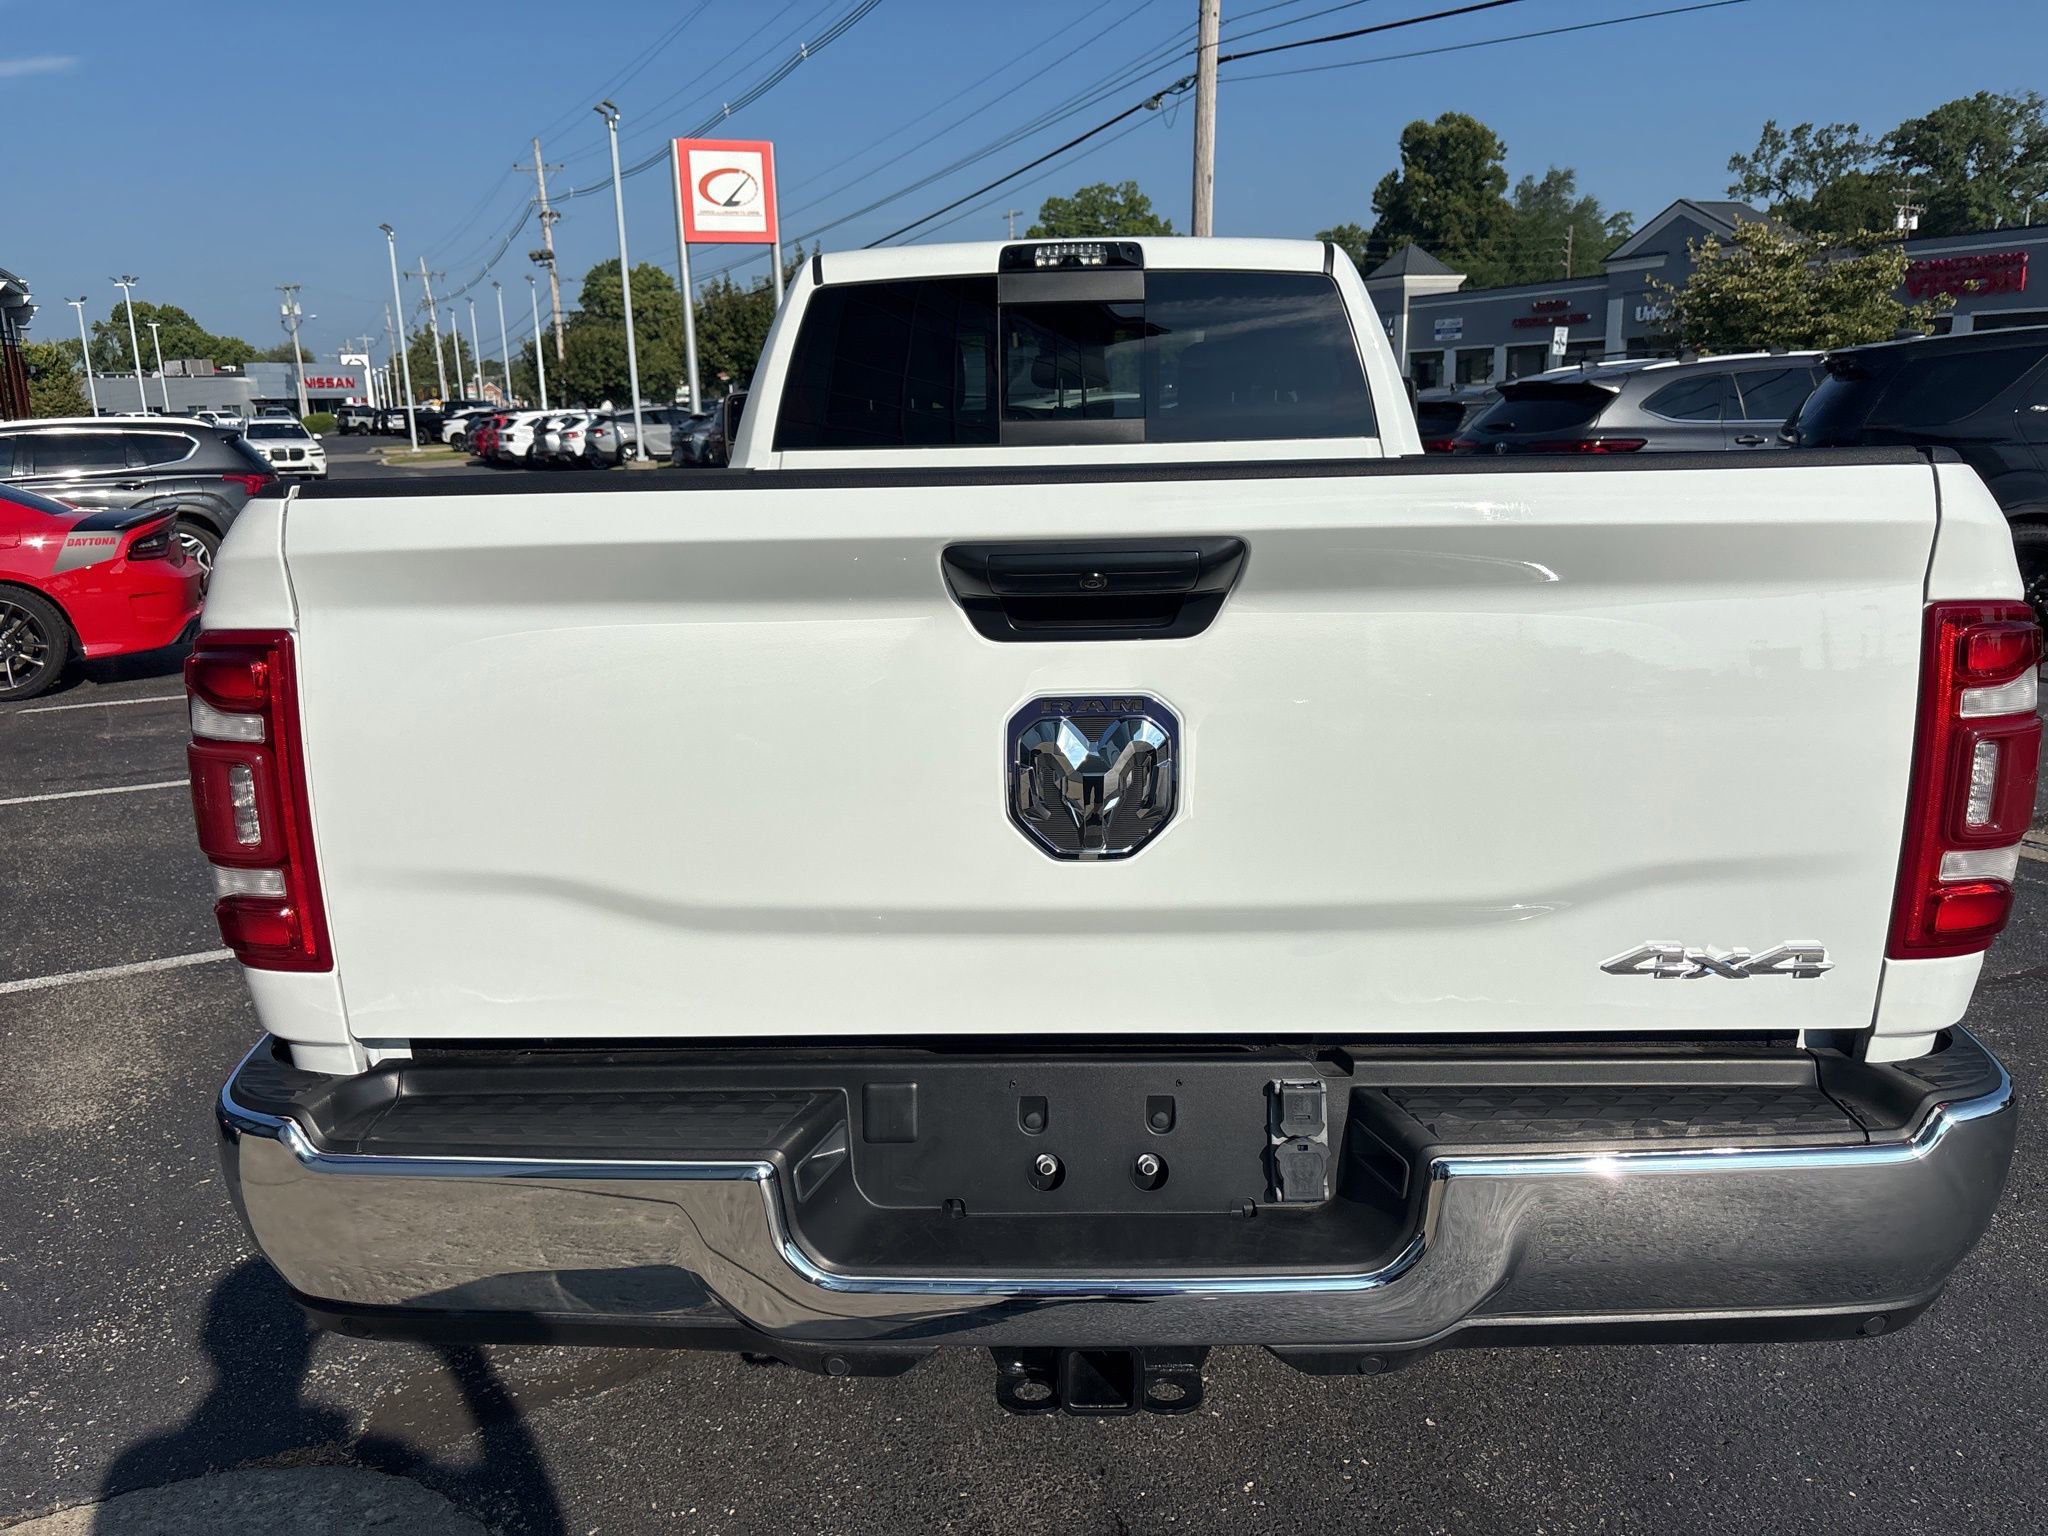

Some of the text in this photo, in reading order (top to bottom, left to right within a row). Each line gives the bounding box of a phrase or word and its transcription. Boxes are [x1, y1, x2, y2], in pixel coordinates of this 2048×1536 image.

[304, 377, 355, 389] NISSAN
[66, 536, 117, 548] DAYTONA
[1040, 698, 1145, 714] RAM
